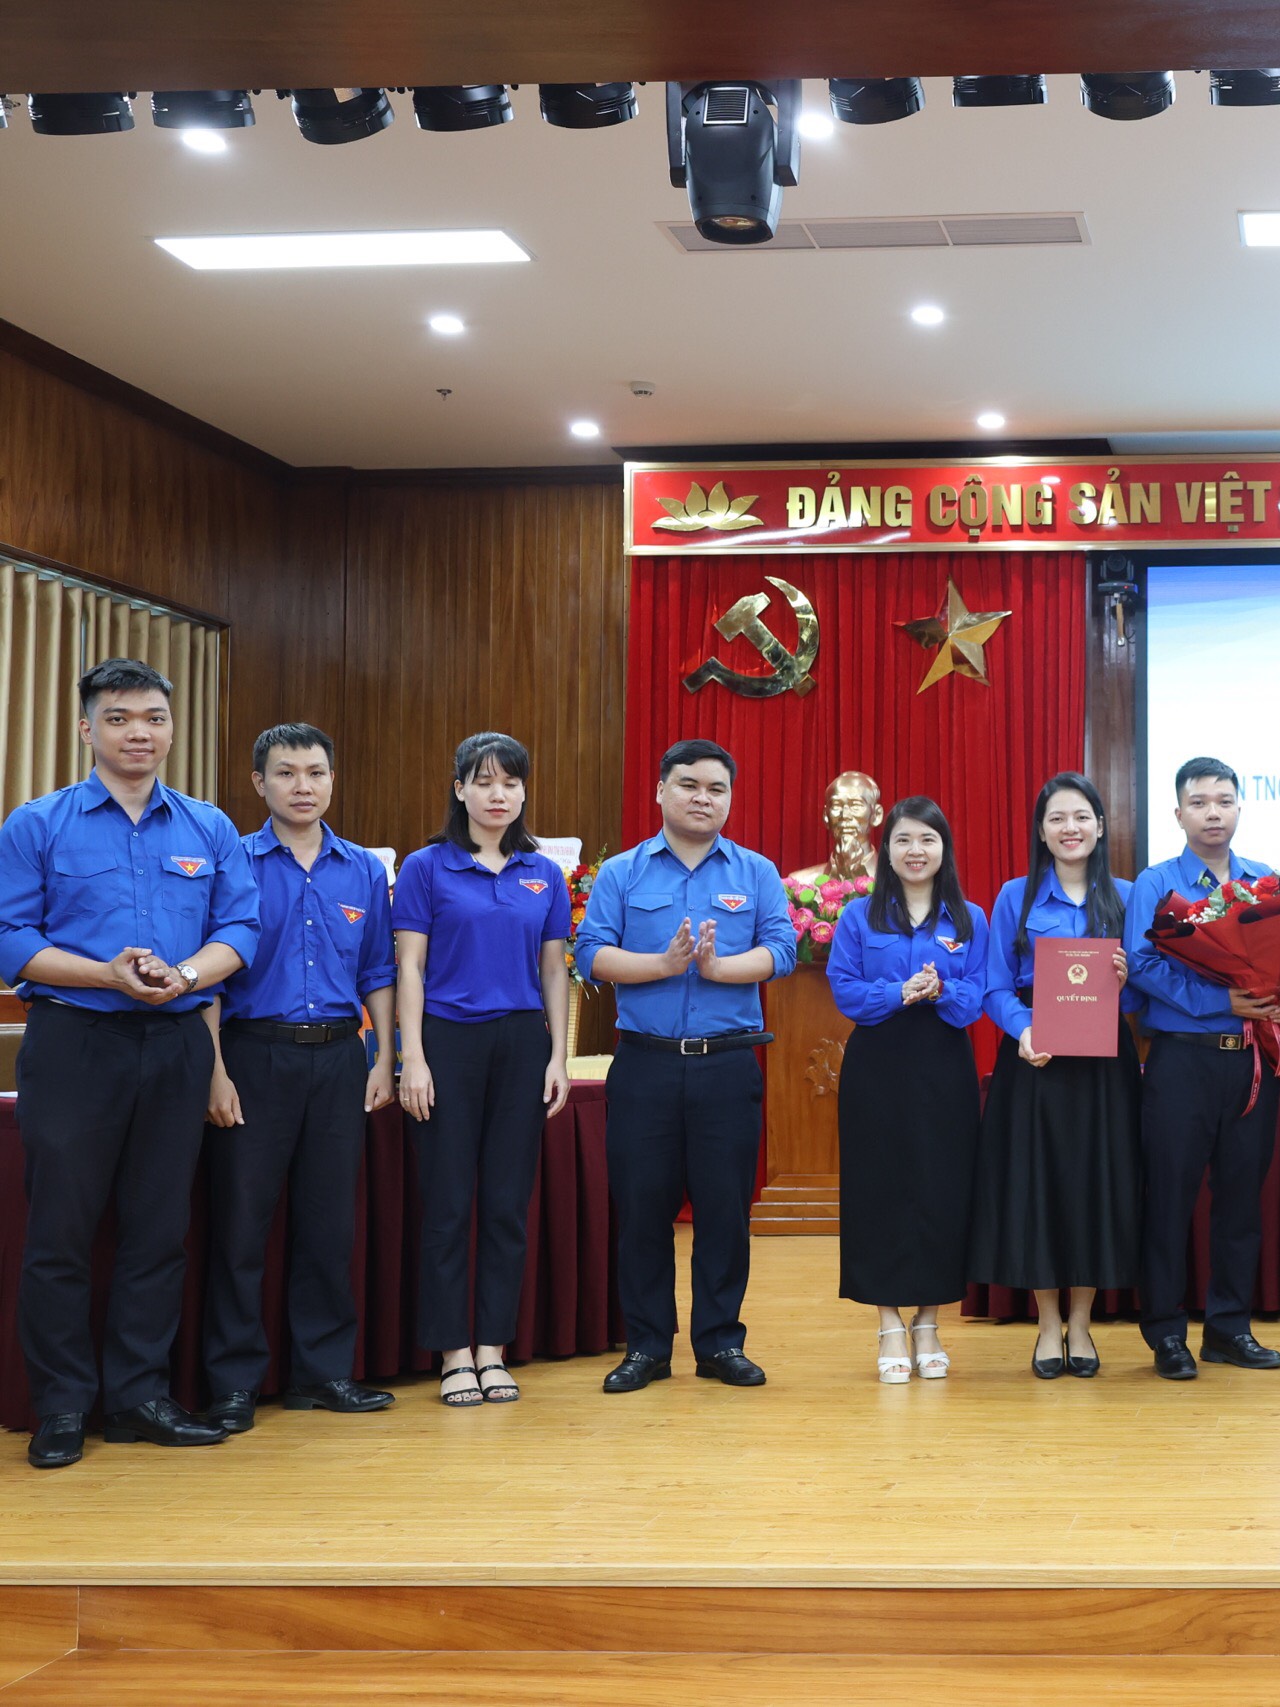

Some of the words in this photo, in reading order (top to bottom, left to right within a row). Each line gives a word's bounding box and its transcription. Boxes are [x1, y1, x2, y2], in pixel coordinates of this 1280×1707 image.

[786, 471, 912, 528] ĐẢNG
[929, 474, 1053, 536] CỘNG
[1068, 467, 1161, 525] SẢN
[1175, 471, 1271, 532] VIỆT
